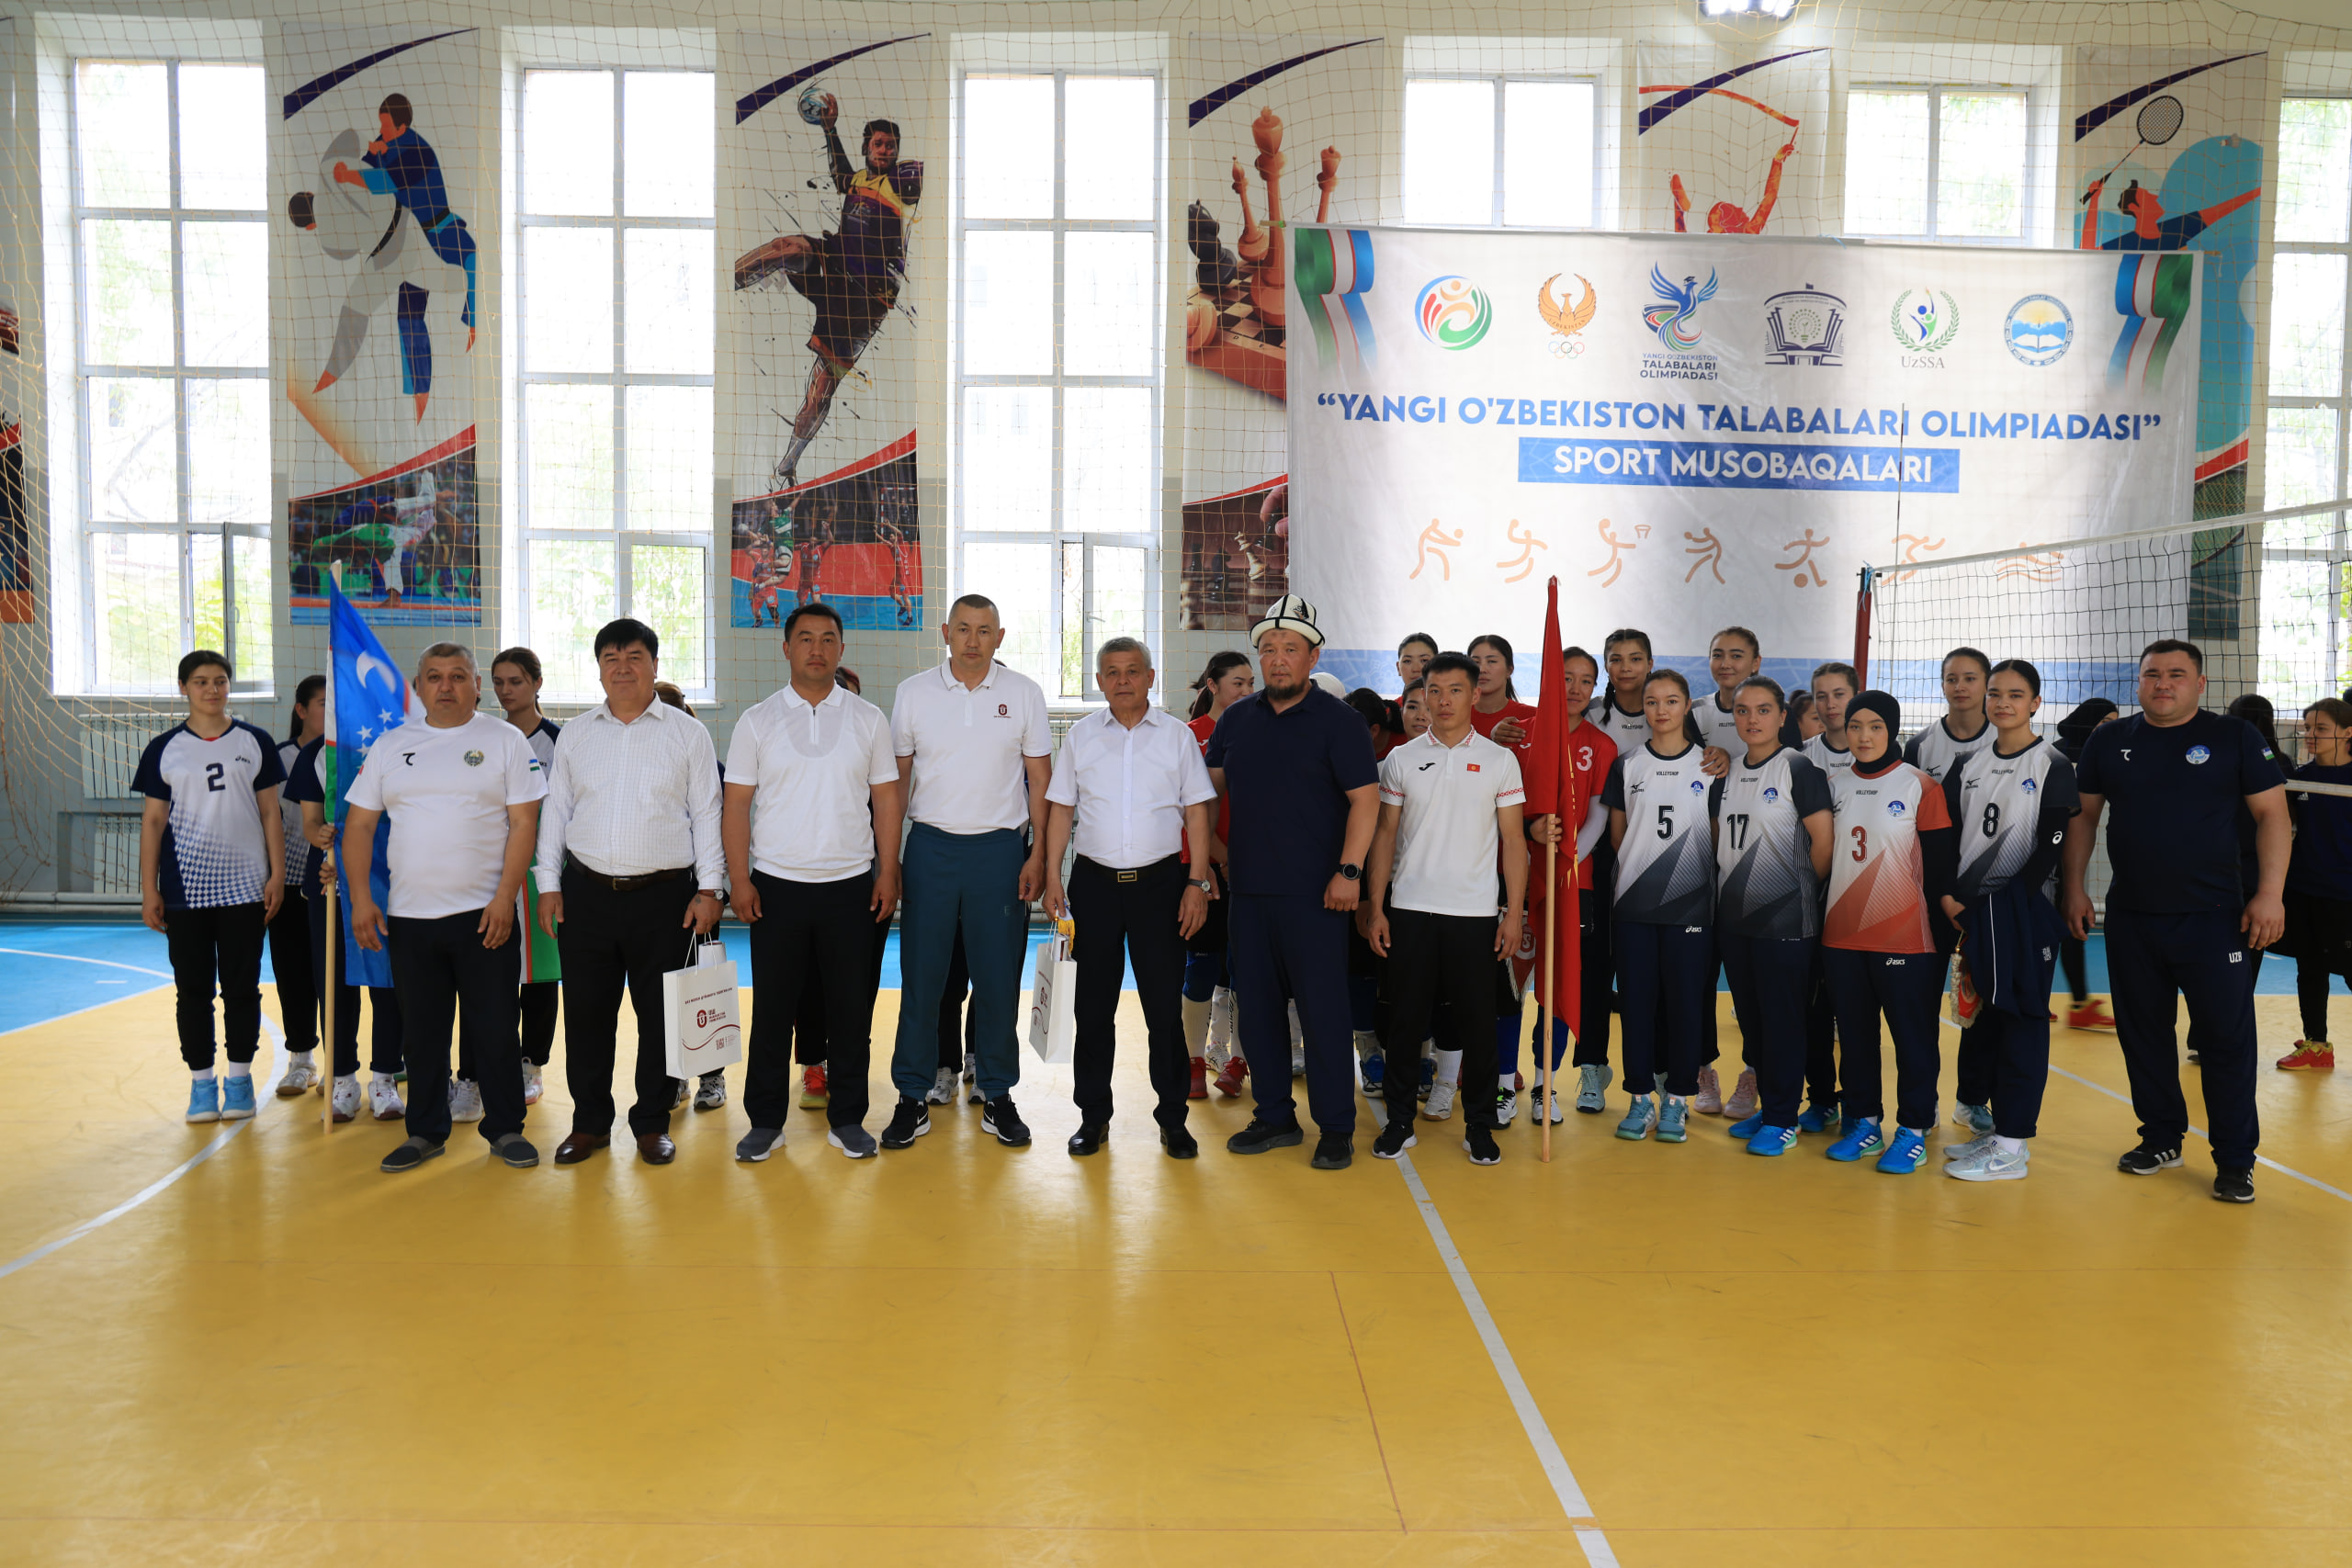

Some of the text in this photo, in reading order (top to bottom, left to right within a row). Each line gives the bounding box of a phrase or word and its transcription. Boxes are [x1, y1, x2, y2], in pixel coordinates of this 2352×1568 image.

[1640, 369, 1717, 380] OLIMPIADASI
[1643, 360, 1716, 370] TALABALARI
[1901, 355, 1945, 368] UzSSA
[1458, 397, 1685, 431] O'ZBEKISTON
[1698, 404, 1909, 436] TALABALARI
[1554, 446, 1931, 483] SPORT MUSOBAQALARI
[1577, 746, 1593, 772] 3
[206, 762, 226, 792] 2
[1657, 806, 1674, 840] 5
[1727, 814, 1749, 850] 17
[1983, 803, 2000, 839] 8
[1851, 826, 1867, 863] 3
[2229, 951, 2243, 963] UZB
